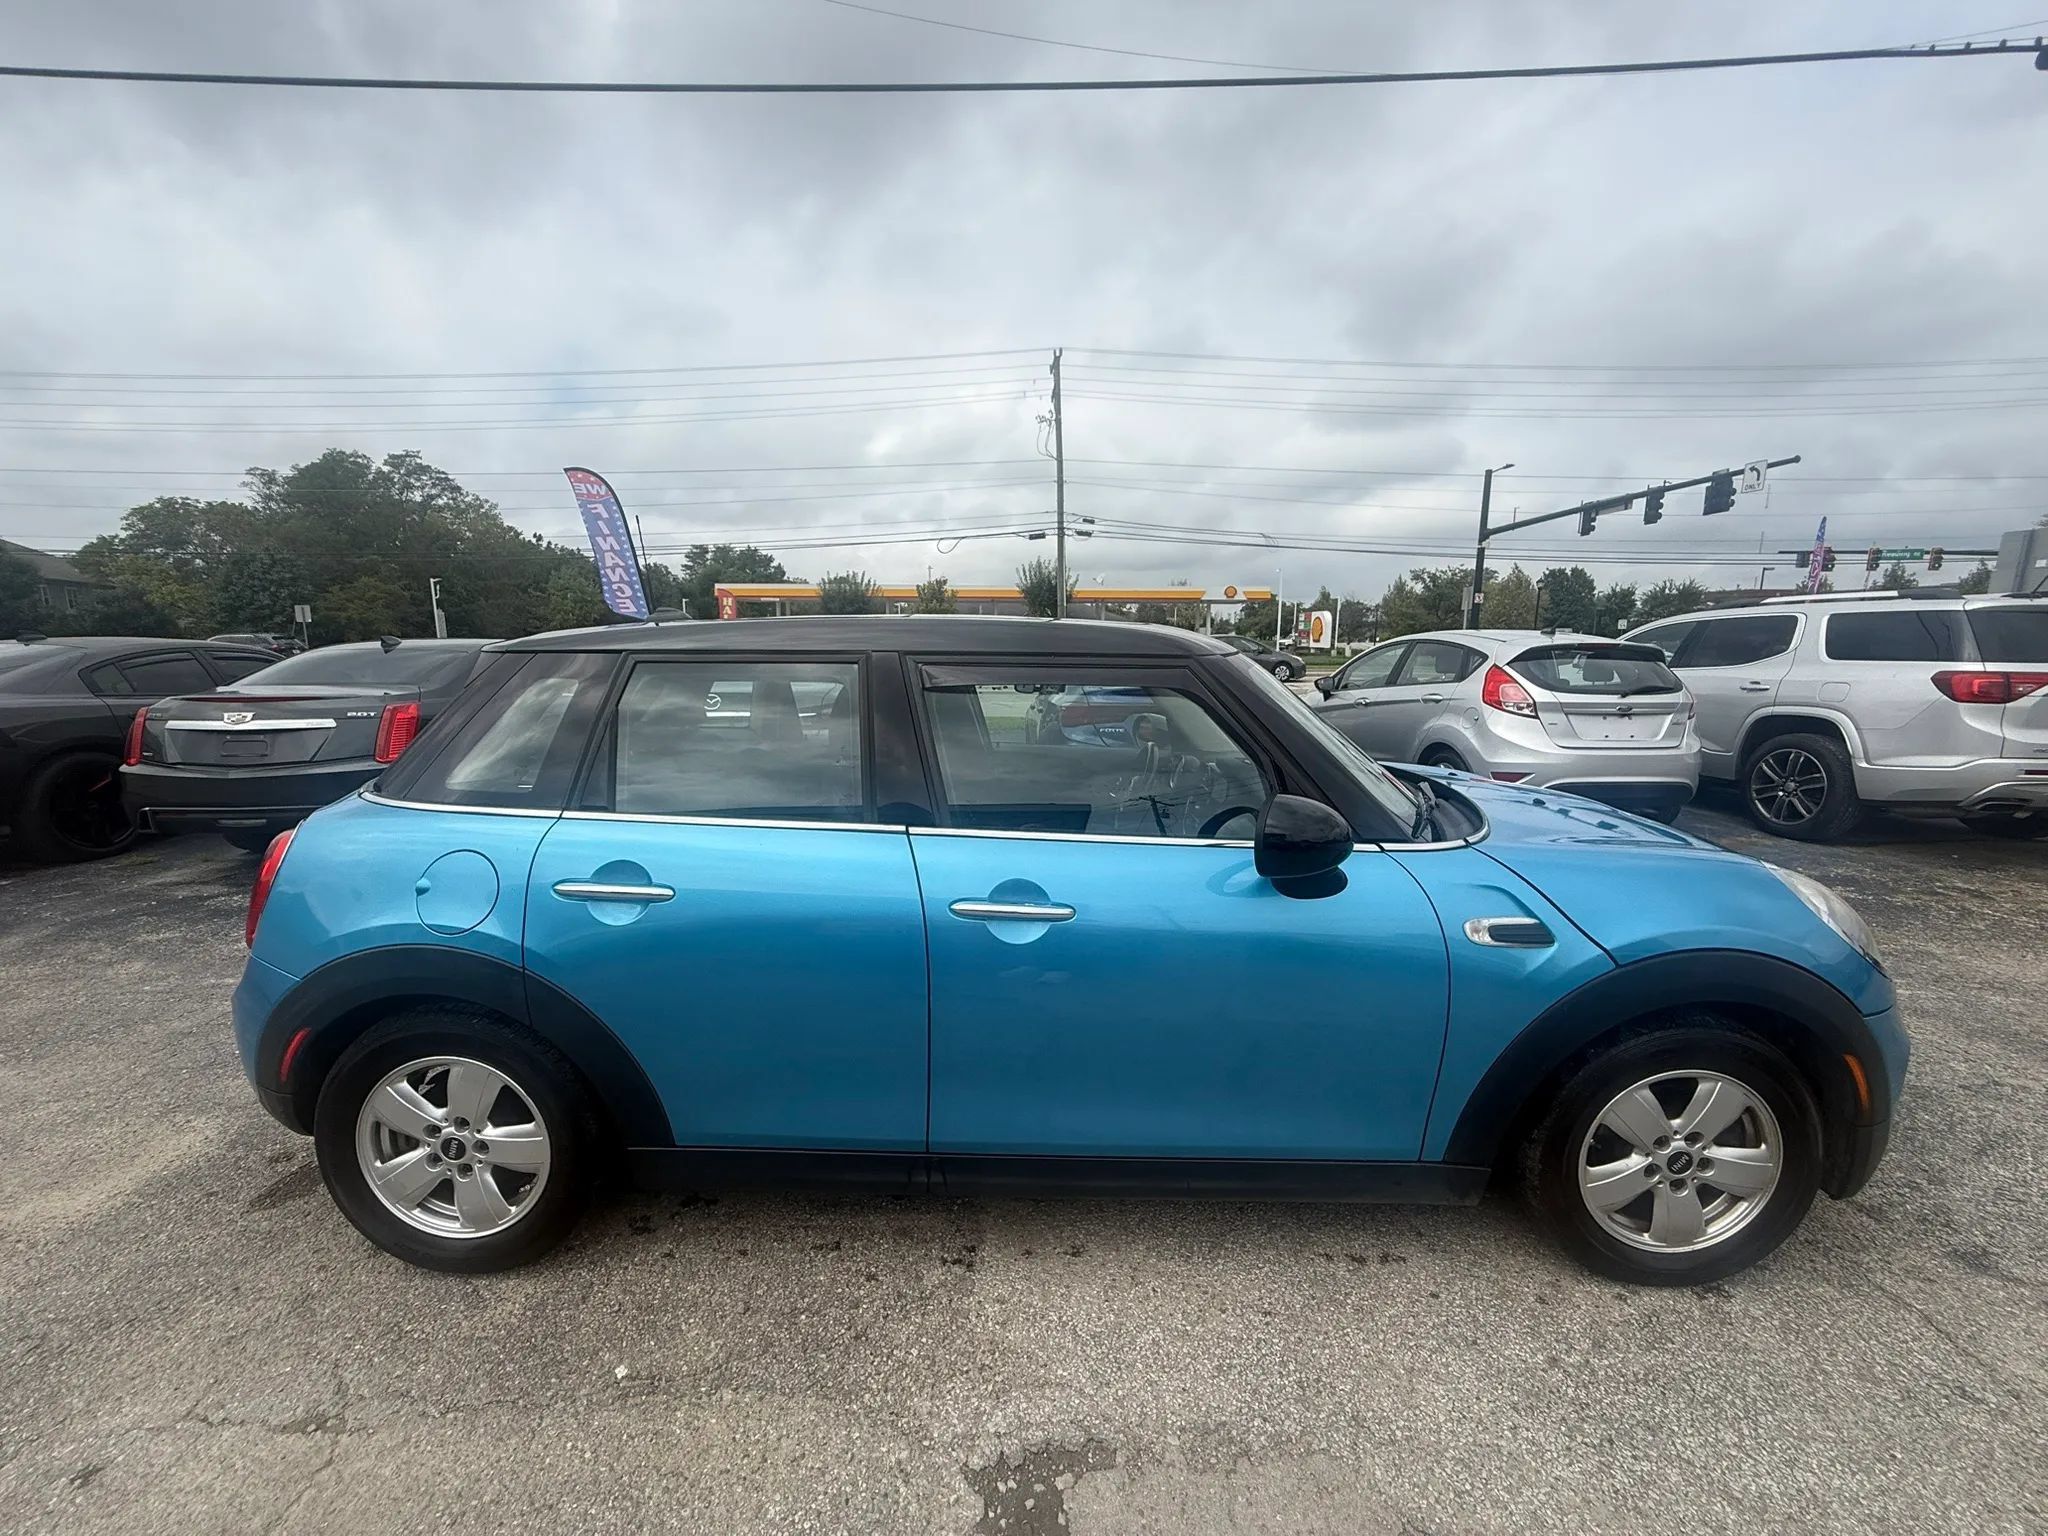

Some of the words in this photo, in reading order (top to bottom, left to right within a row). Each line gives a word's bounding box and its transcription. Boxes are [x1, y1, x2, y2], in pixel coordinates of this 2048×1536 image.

[1744, 482, 1761, 491] ONLY
[448, 1139, 458, 1159] MINI
[1671, 1154, 1690, 1172] MINI
